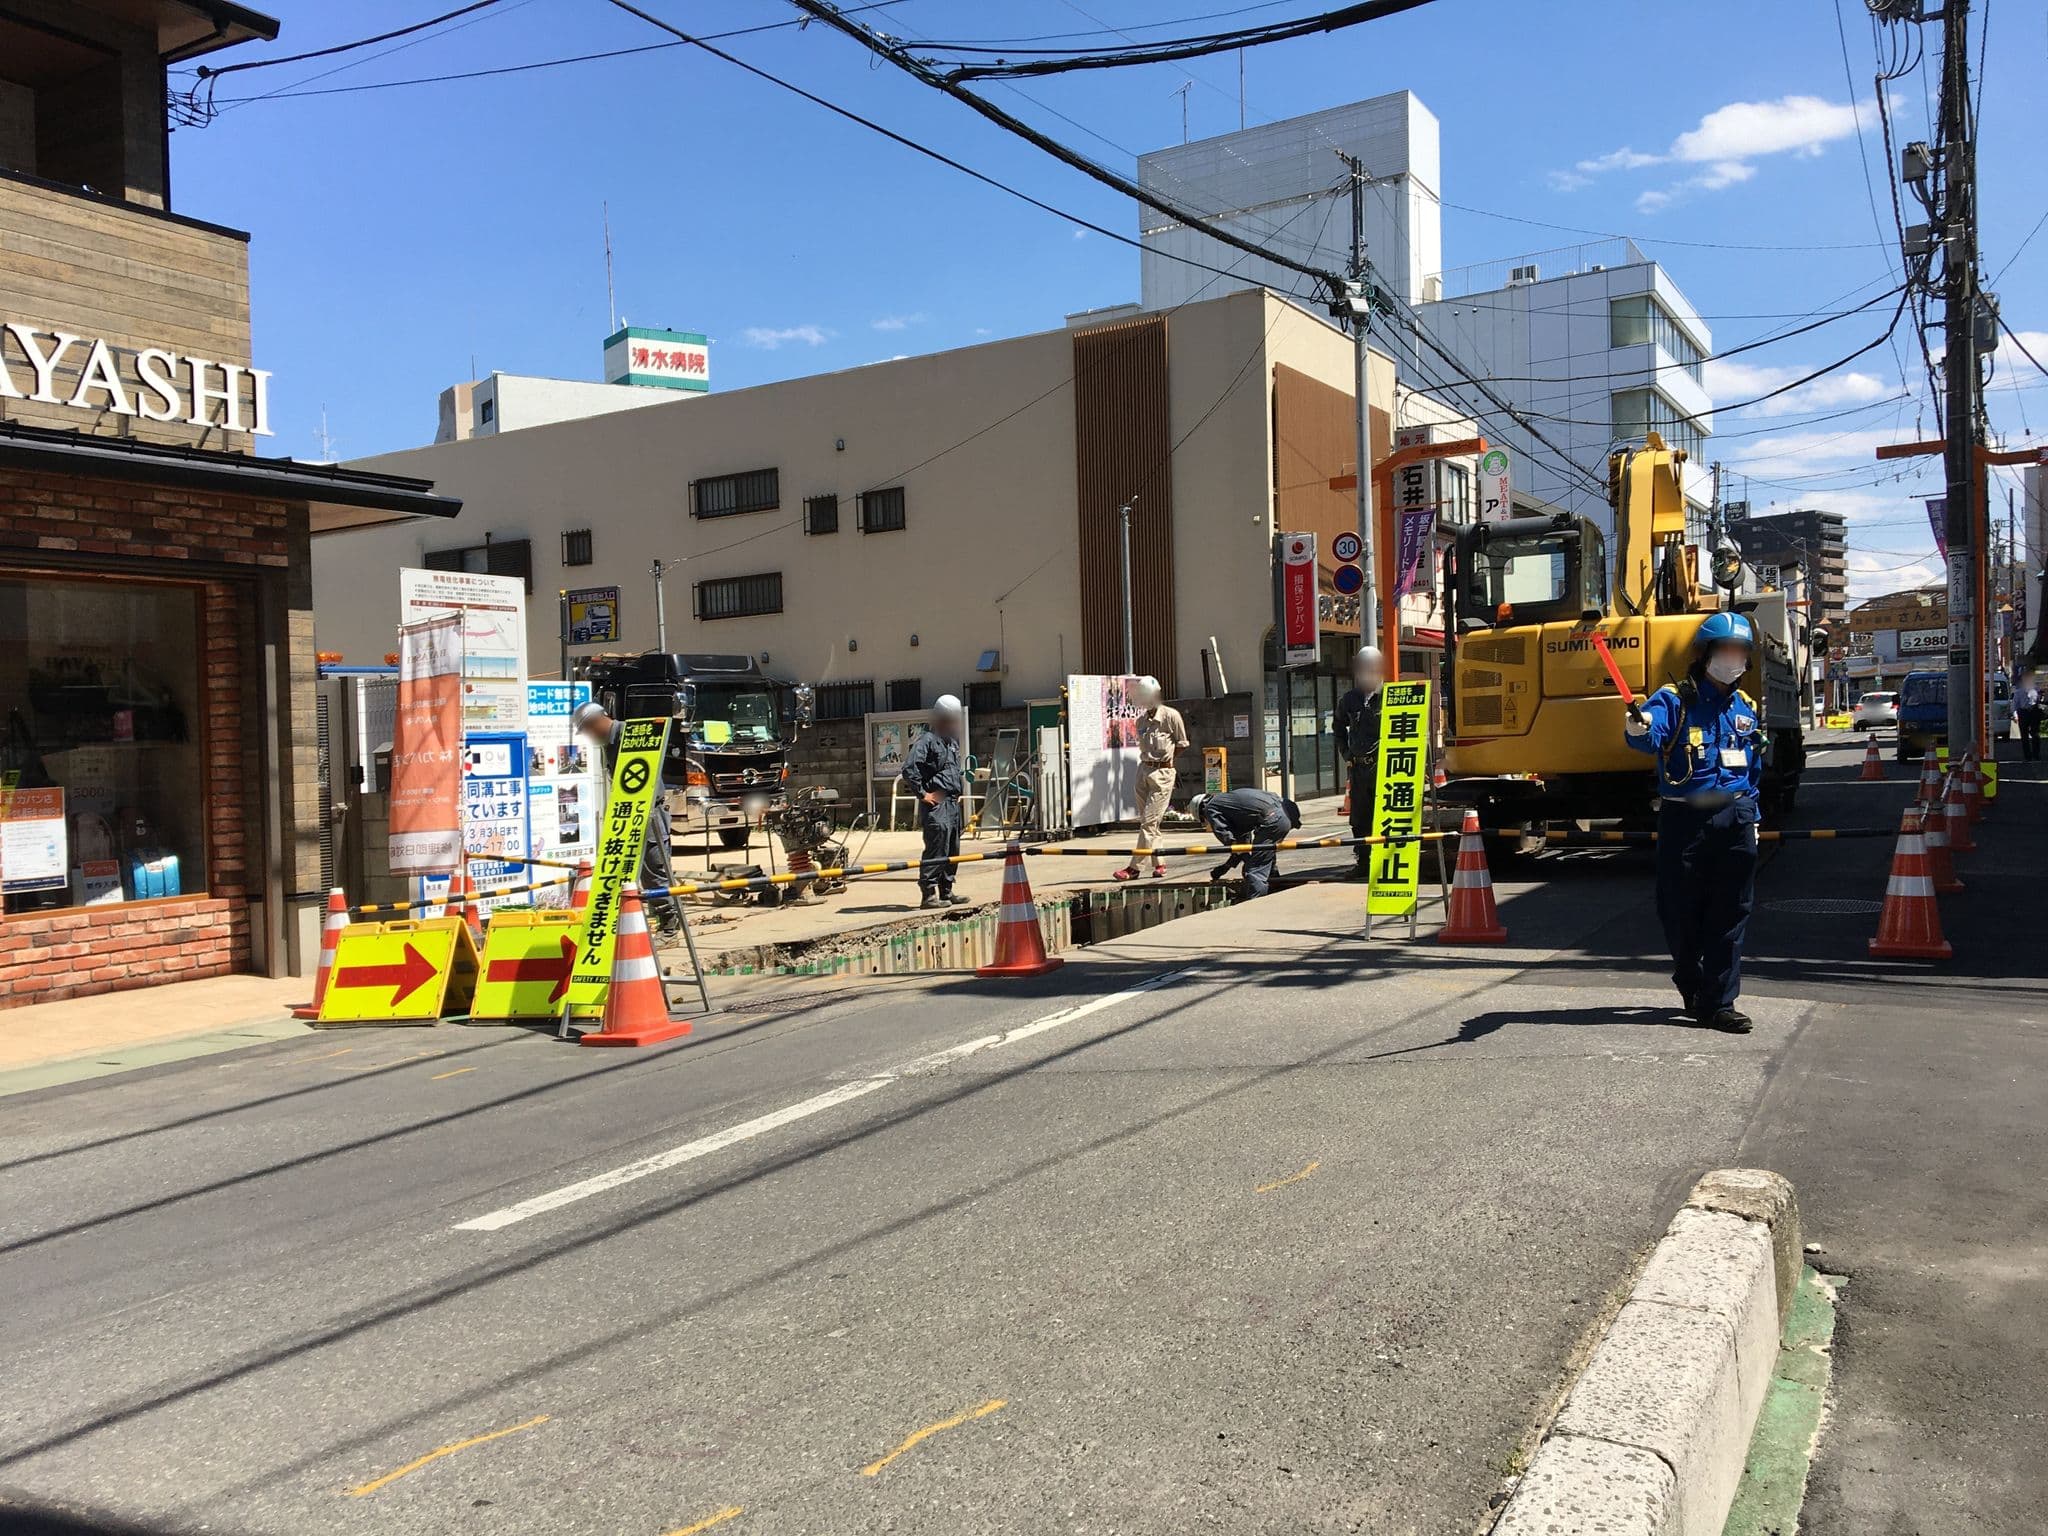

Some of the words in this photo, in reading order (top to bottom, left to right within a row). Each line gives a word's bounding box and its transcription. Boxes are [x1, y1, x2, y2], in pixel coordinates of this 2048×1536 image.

[632, 347, 705, 374] 清水病院
[1401, 434, 1425, 446] 地元
[1339, 540, 1356, 555] 30
[1388, 687, 1413, 697] ご迷惑を
[1387, 694, 1425, 705] おかけします
[625, 723, 653, 736] ご迷惑を
[622, 735, 663, 749] おかけします
[1377, 711, 1420, 884] 車両通行止
[467, 801, 522, 819] ています
[581, 801, 633, 966] 通り抜けできません
